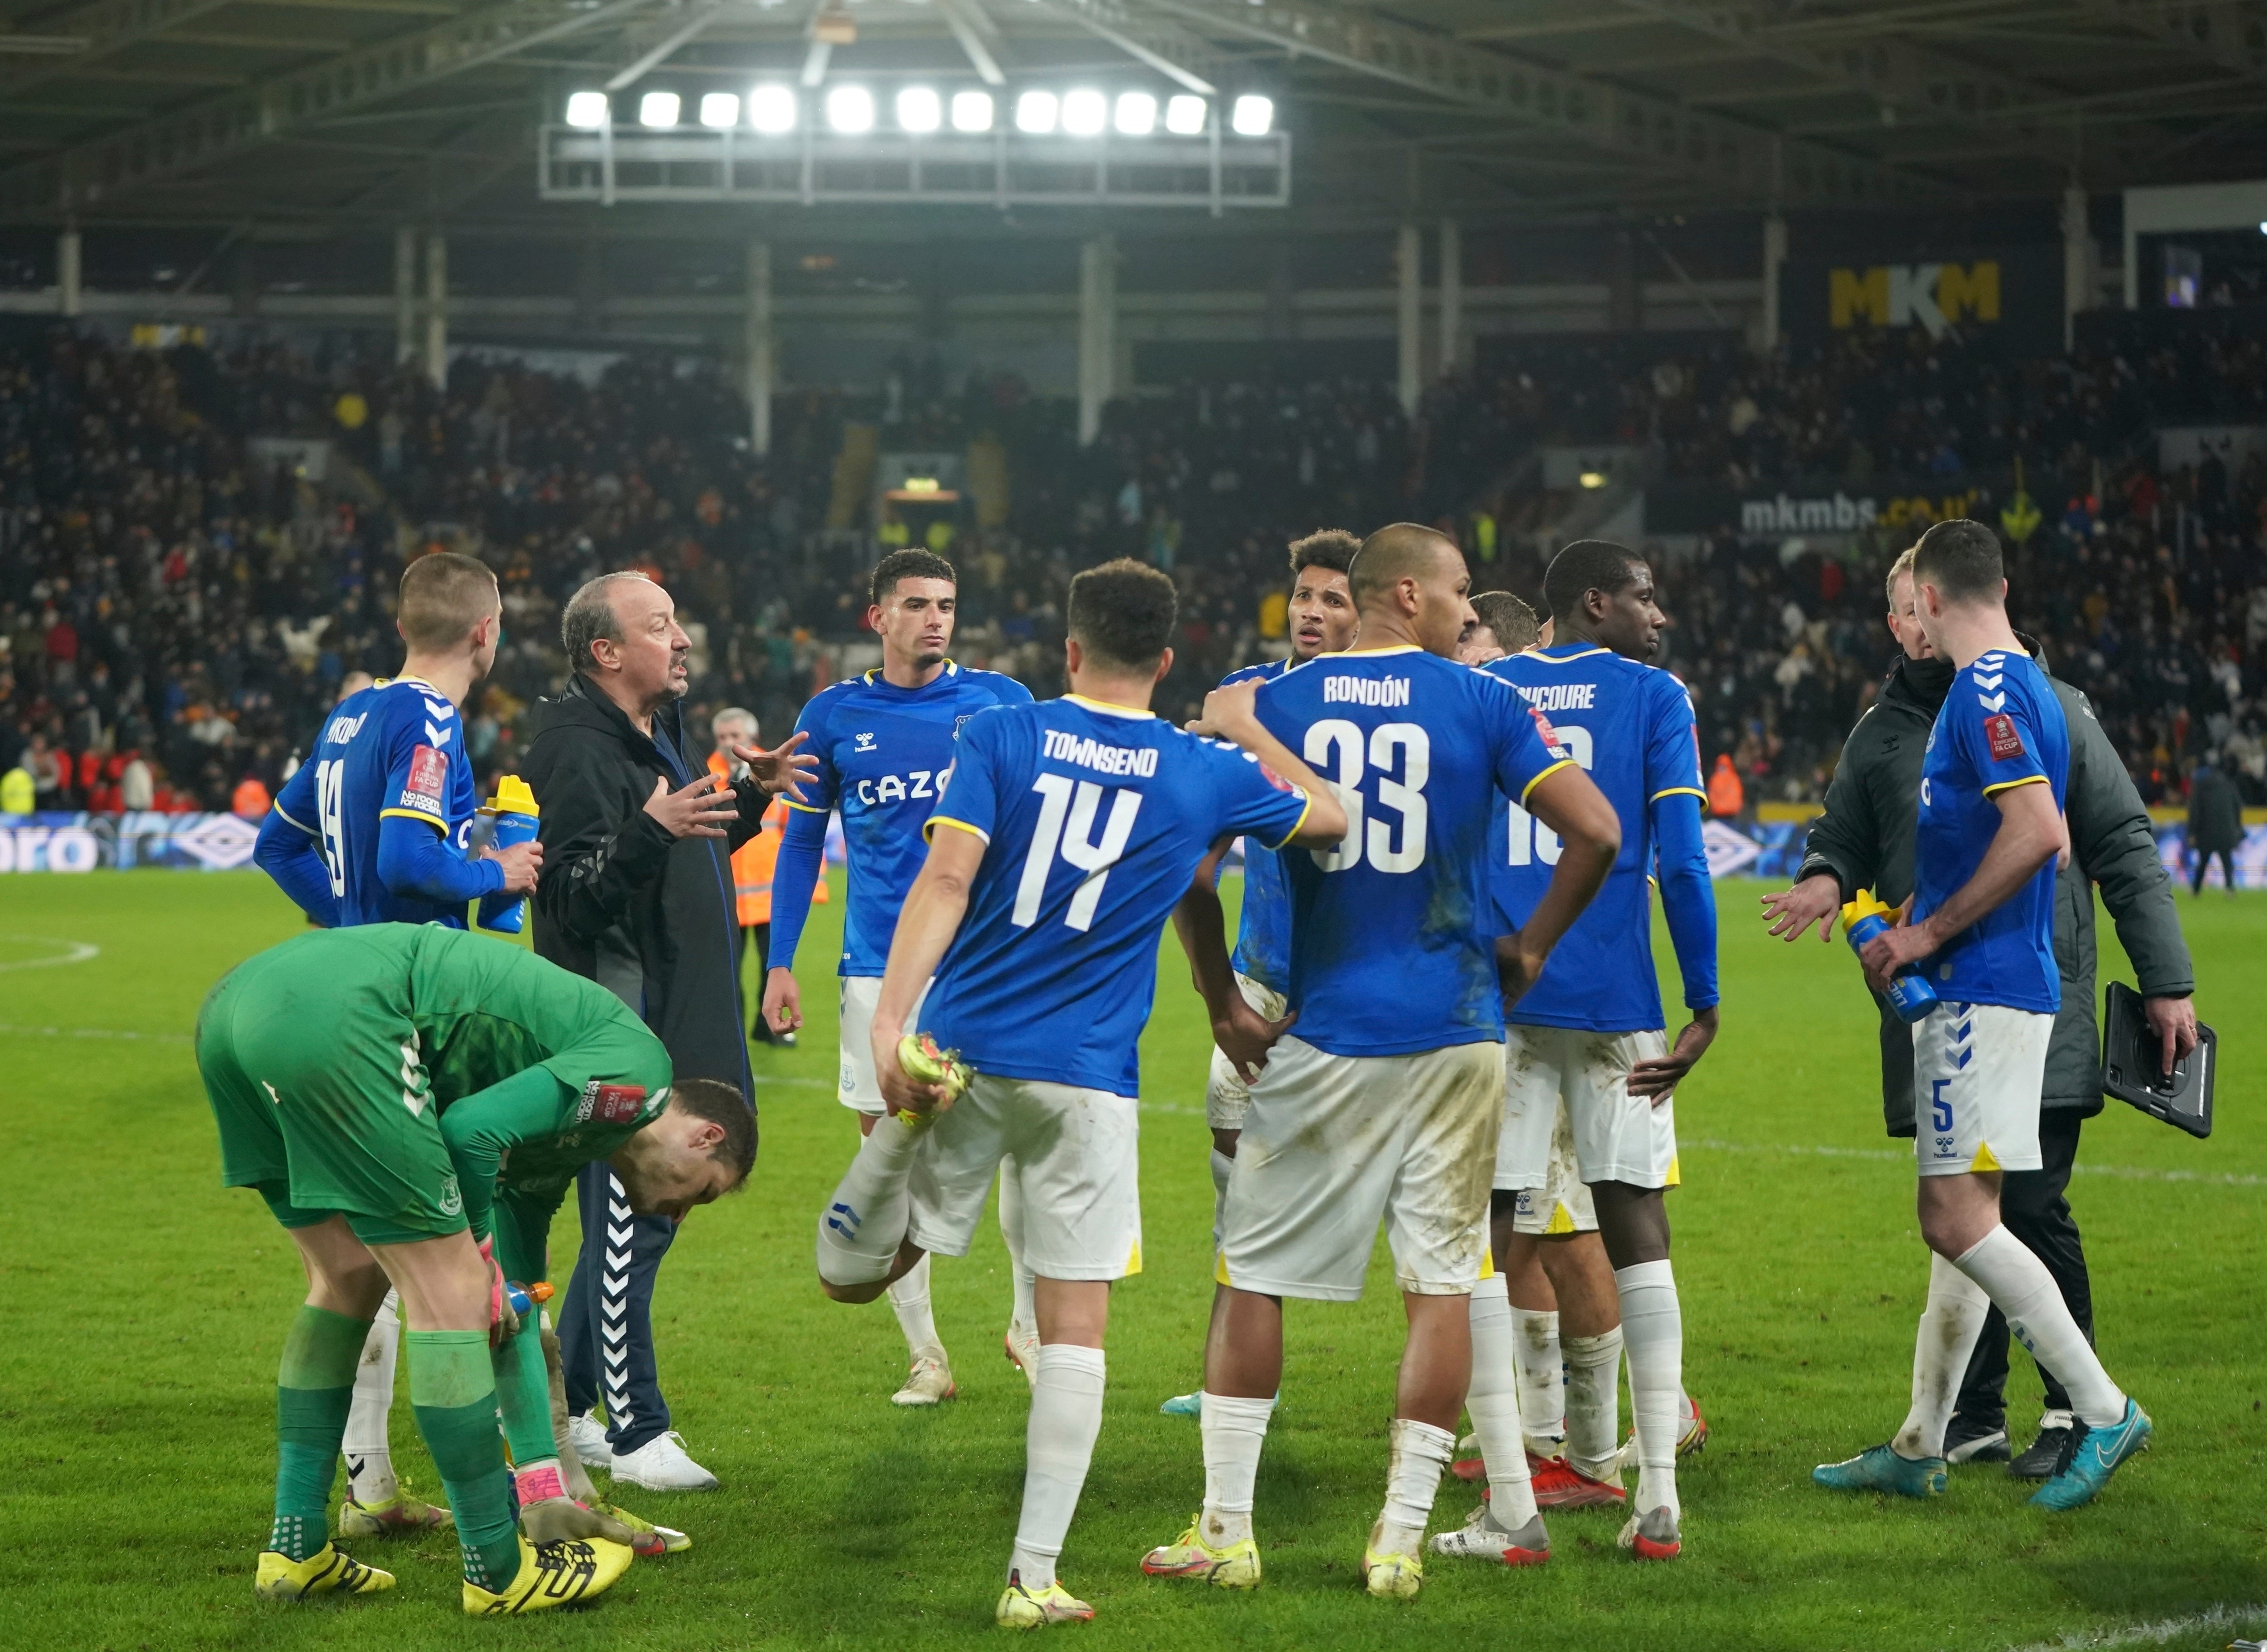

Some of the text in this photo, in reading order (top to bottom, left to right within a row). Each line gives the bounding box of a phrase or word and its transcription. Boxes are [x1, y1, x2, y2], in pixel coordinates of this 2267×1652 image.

[1830, 260, 1999, 342] MKM
[1742, 488, 1978, 532] mkmbs.co.u
[1323, 675, 1410, 707] RONDÓN
[1044, 729, 1158, 778] TOWNSEND
[402, 790, 440, 809] No room
[425, 779, 438, 788] CUP
[1304, 719, 1430, 873] 33
[315, 759, 345, 898] 19
[400, 797, 441, 817] for racism
[1011, 773, 1143, 933] 14
[583, 1080, 600, 1120] No room
[1932, 1079, 1953, 1132] 5
